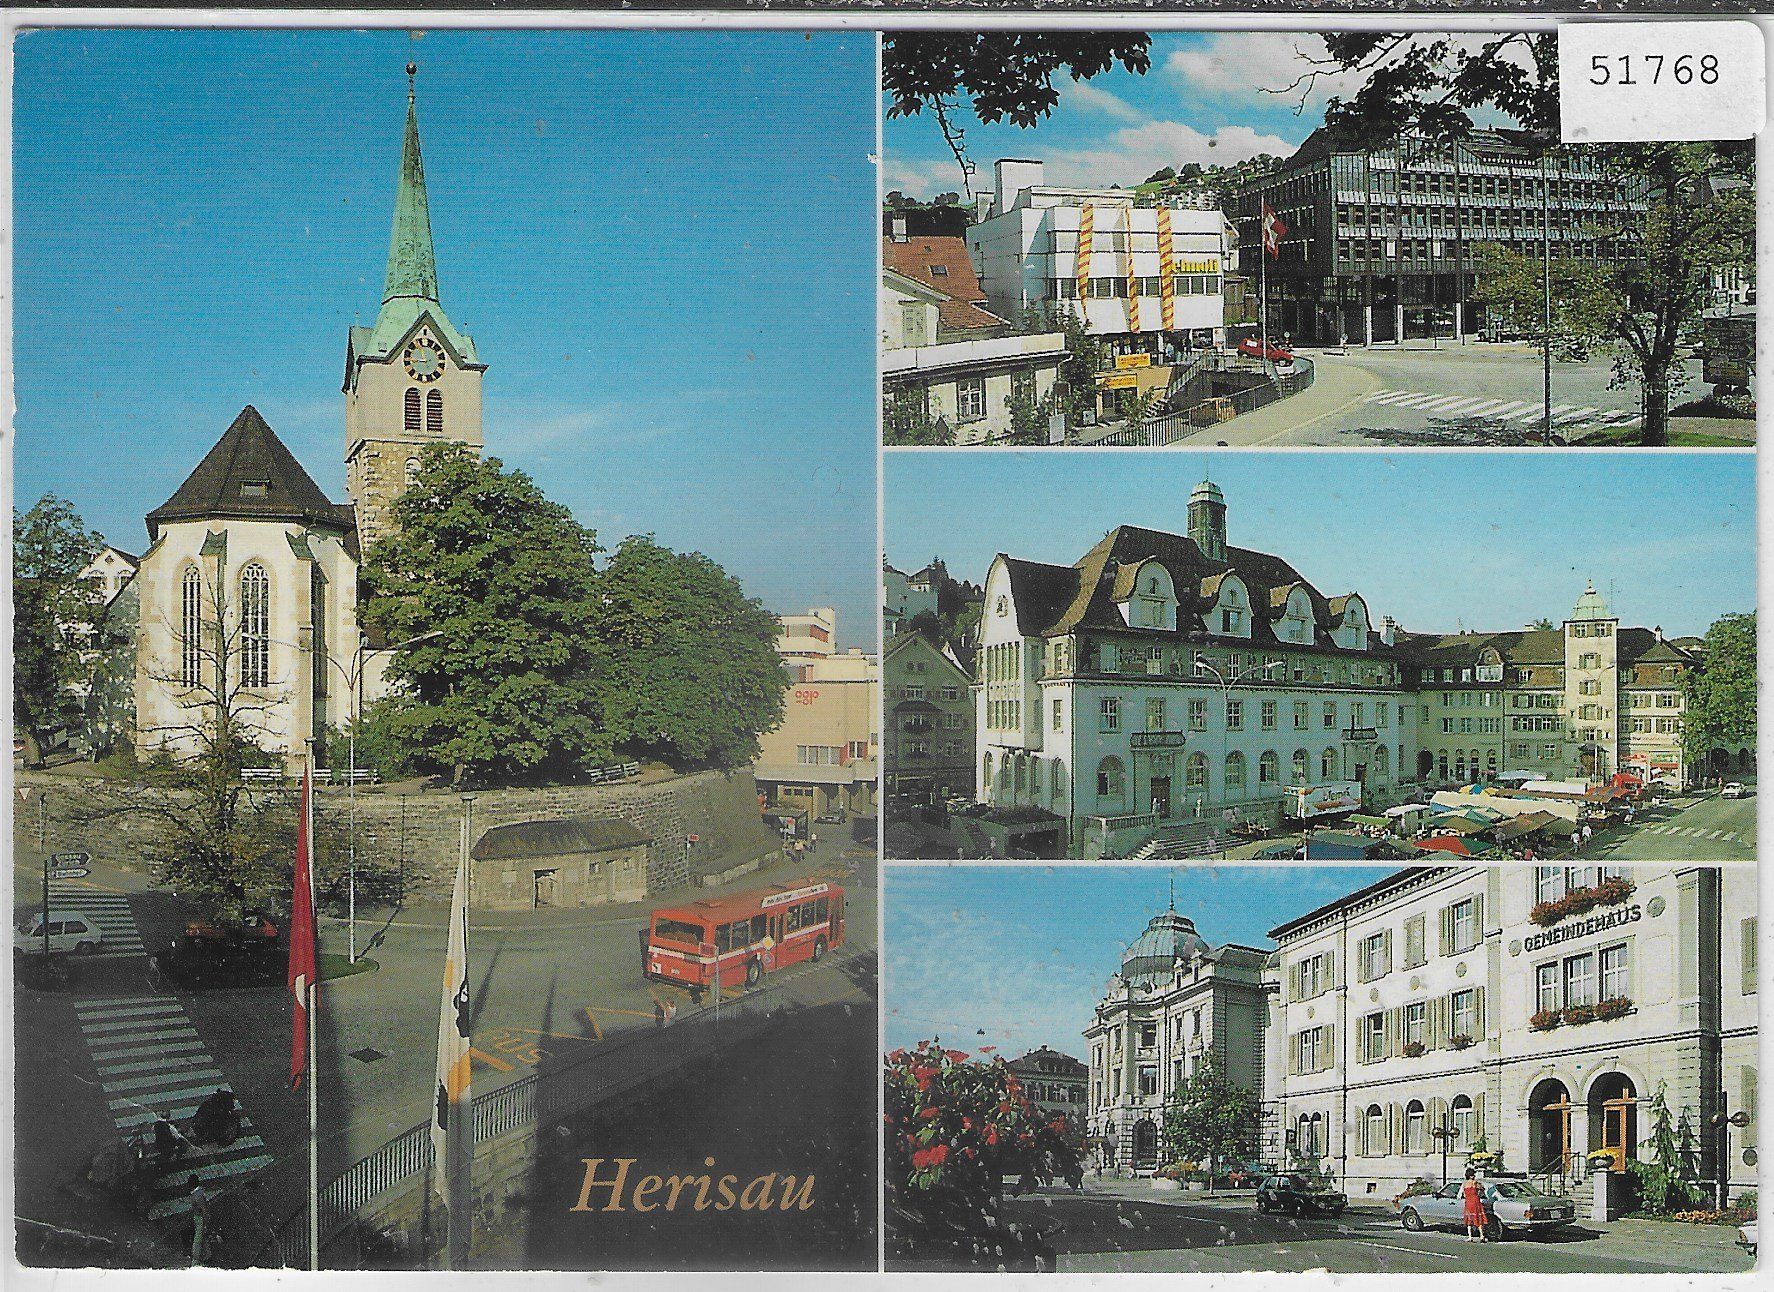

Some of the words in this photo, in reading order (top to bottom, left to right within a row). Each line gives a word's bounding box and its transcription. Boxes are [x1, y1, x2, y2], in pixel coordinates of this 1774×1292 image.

[1590, 54, 1719, 86] 51768
[1525, 904, 1641, 953] GEMEINDEHAUS
[569, 1156, 816, 1212] Herisau
